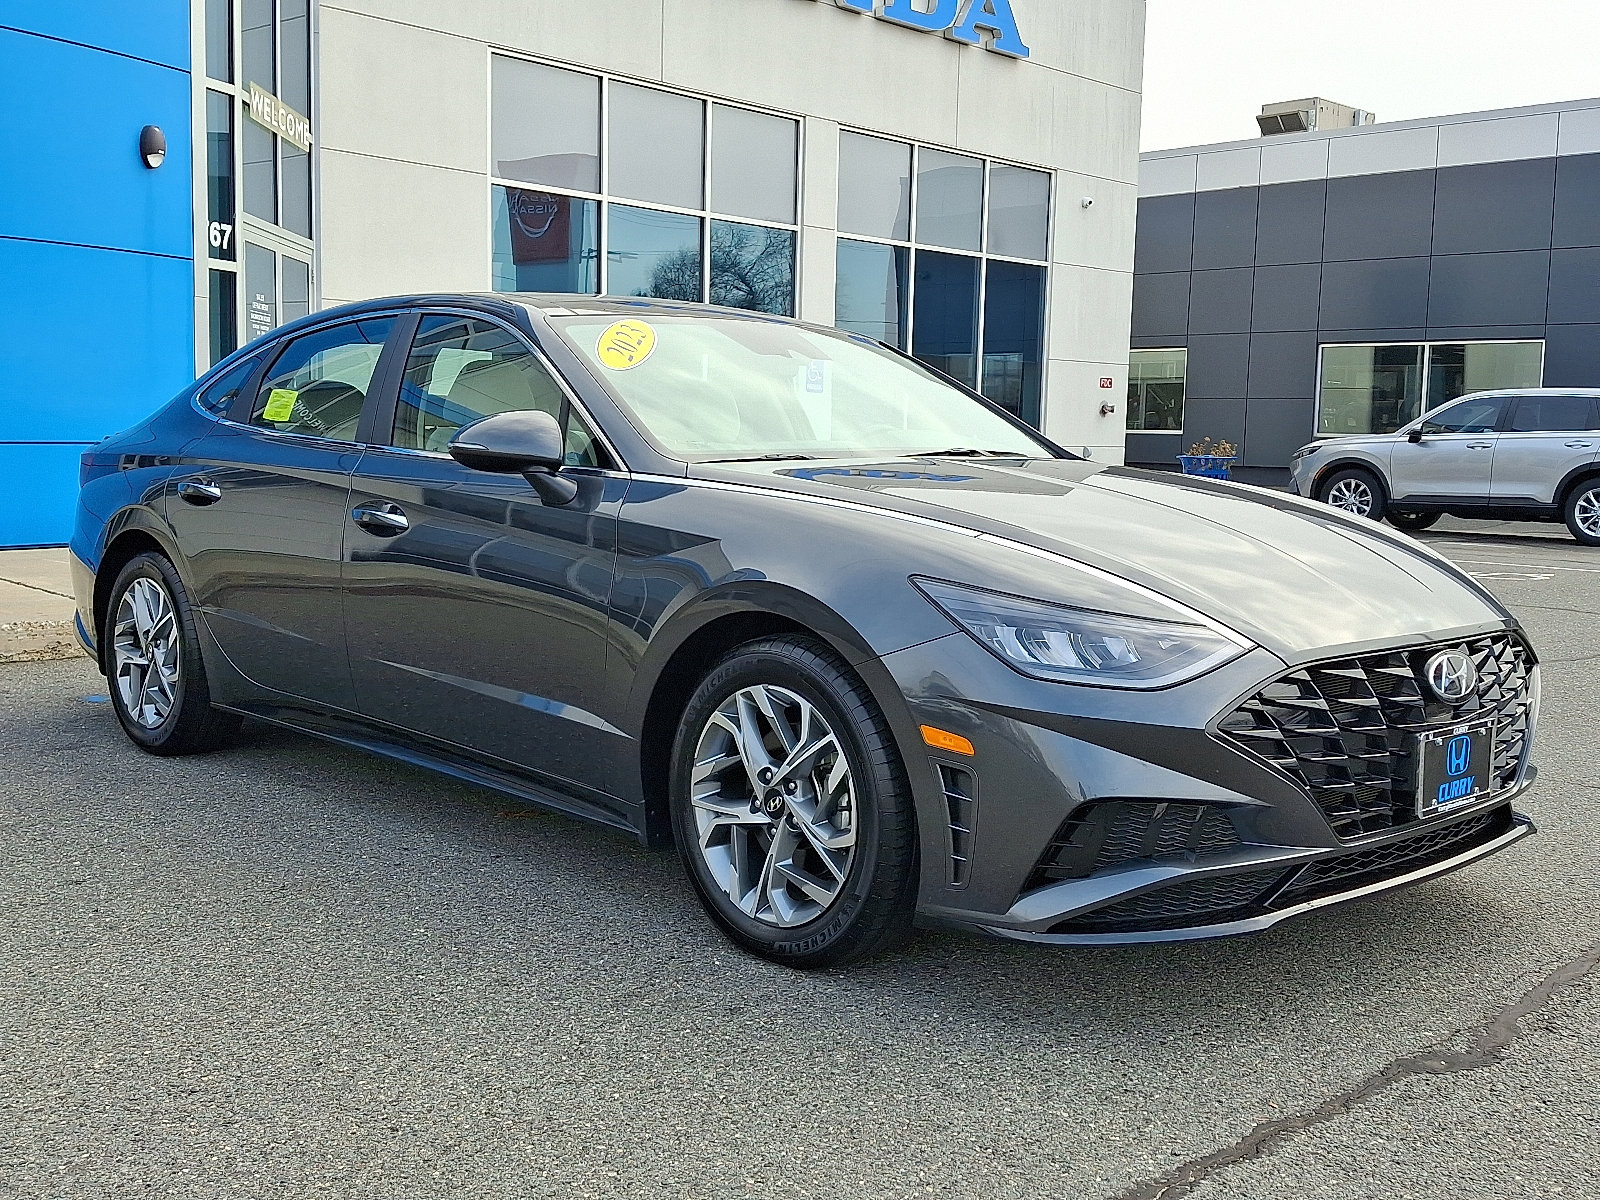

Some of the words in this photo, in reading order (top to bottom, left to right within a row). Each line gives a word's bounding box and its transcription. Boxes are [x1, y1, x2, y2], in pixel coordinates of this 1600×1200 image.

[250, 87, 309, 147] WELCOME
[606, 324, 647, 362] 2023
[1438, 775, 1476, 803] CURRY
